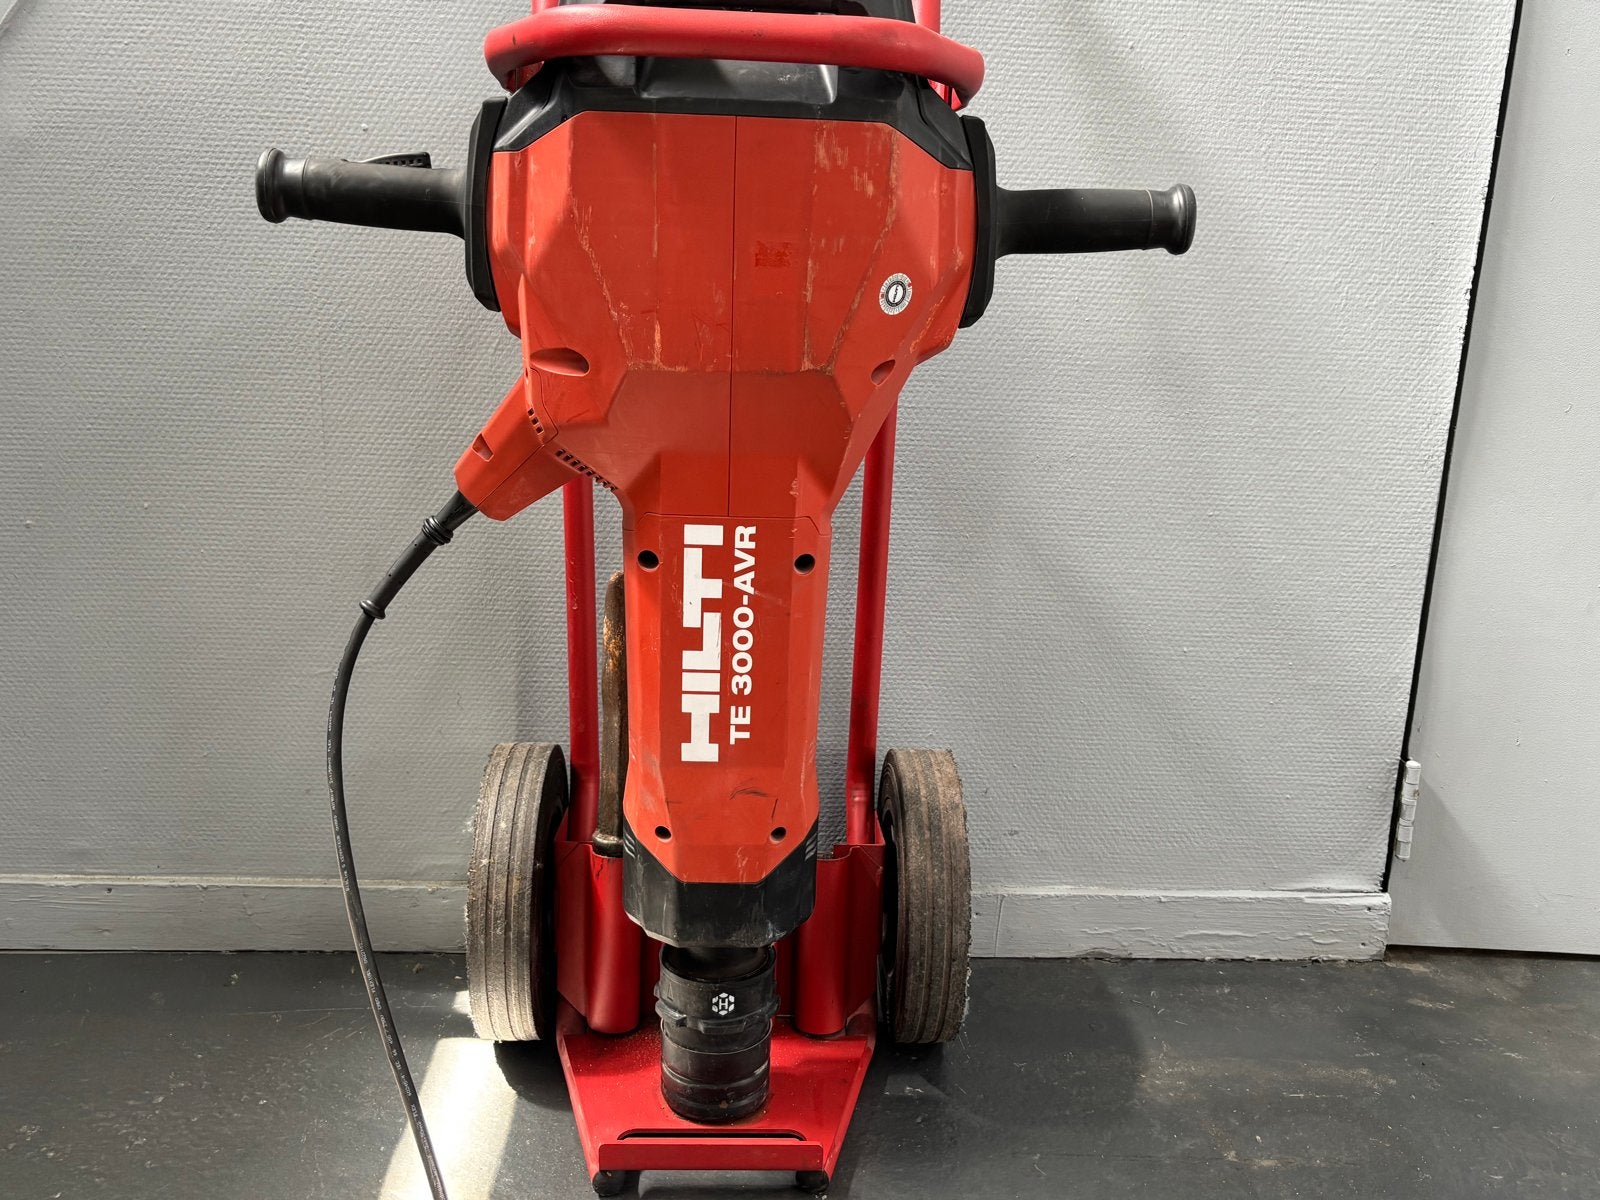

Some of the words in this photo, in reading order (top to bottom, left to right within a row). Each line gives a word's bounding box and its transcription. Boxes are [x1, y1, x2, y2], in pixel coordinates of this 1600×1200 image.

[681, 524, 724, 763] HILTI
[731, 525, 757, 696] 3000-AVR
[730, 705, 751, 745] TE
